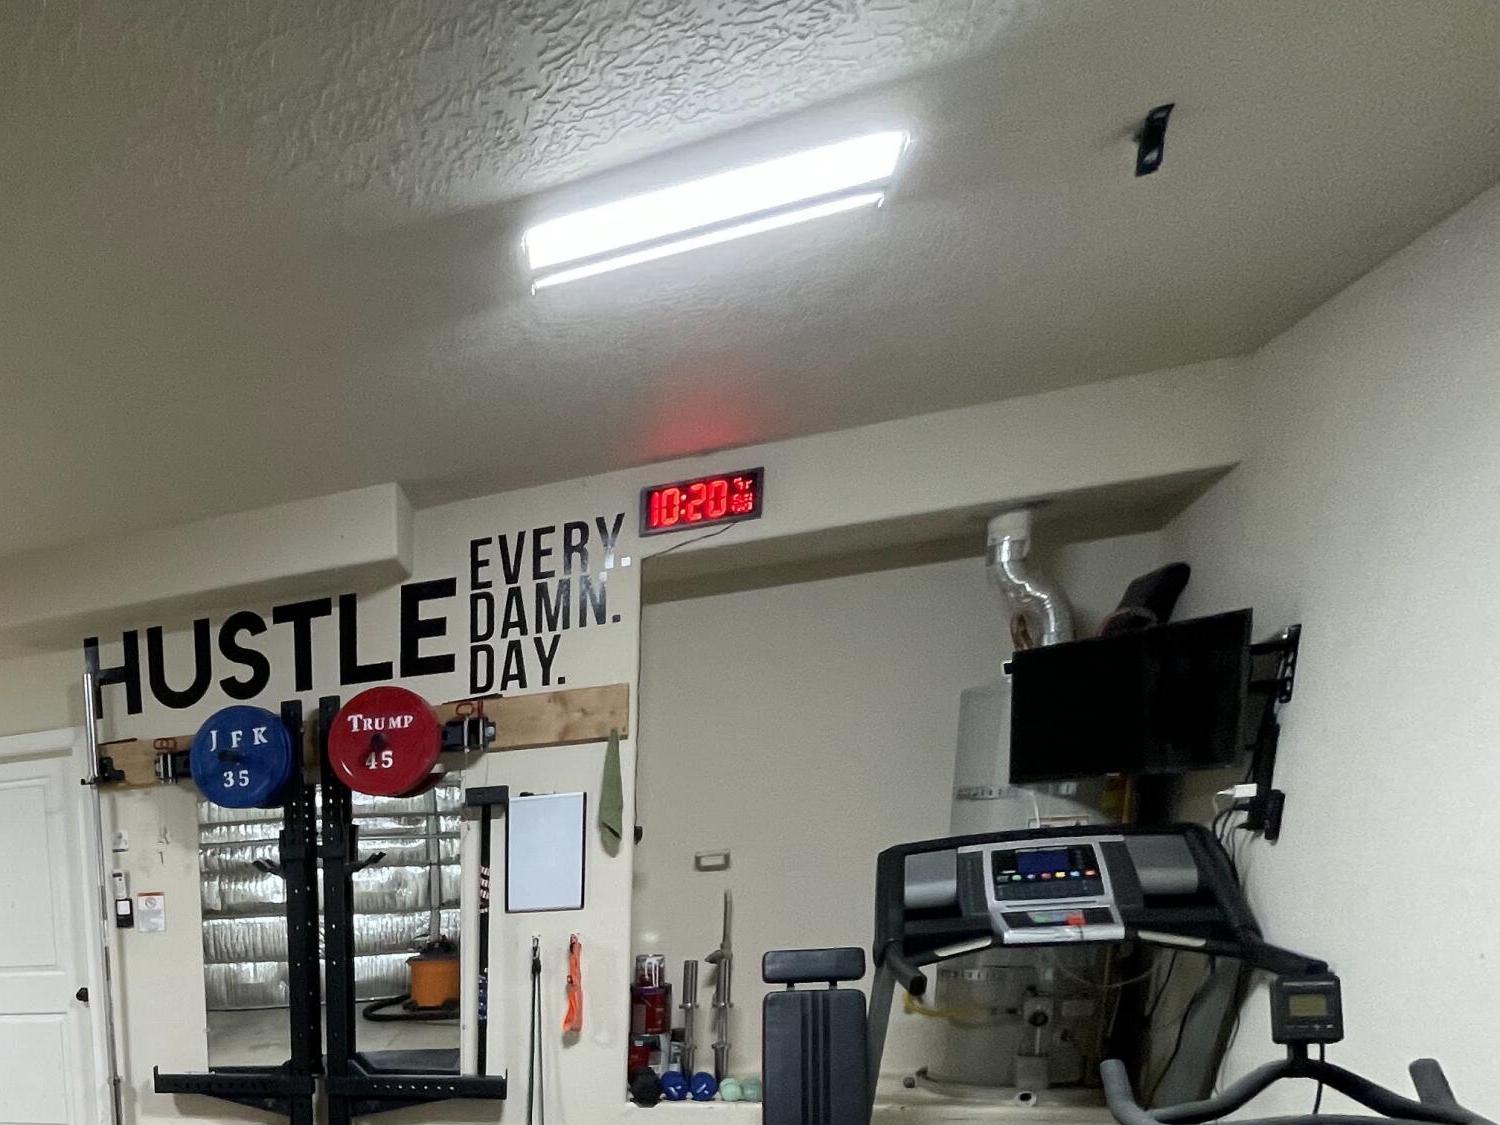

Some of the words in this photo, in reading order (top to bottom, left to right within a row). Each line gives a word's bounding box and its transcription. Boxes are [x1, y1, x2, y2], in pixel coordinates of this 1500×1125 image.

[650, 480, 728, 528] 10:20
[470, 571, 621, 643] DAMN.
[84, 577, 457, 719] HUSTLE
[470, 634, 566, 695] DAY.
[223, 769, 250, 788] 35
[365, 750, 394, 770] 45
